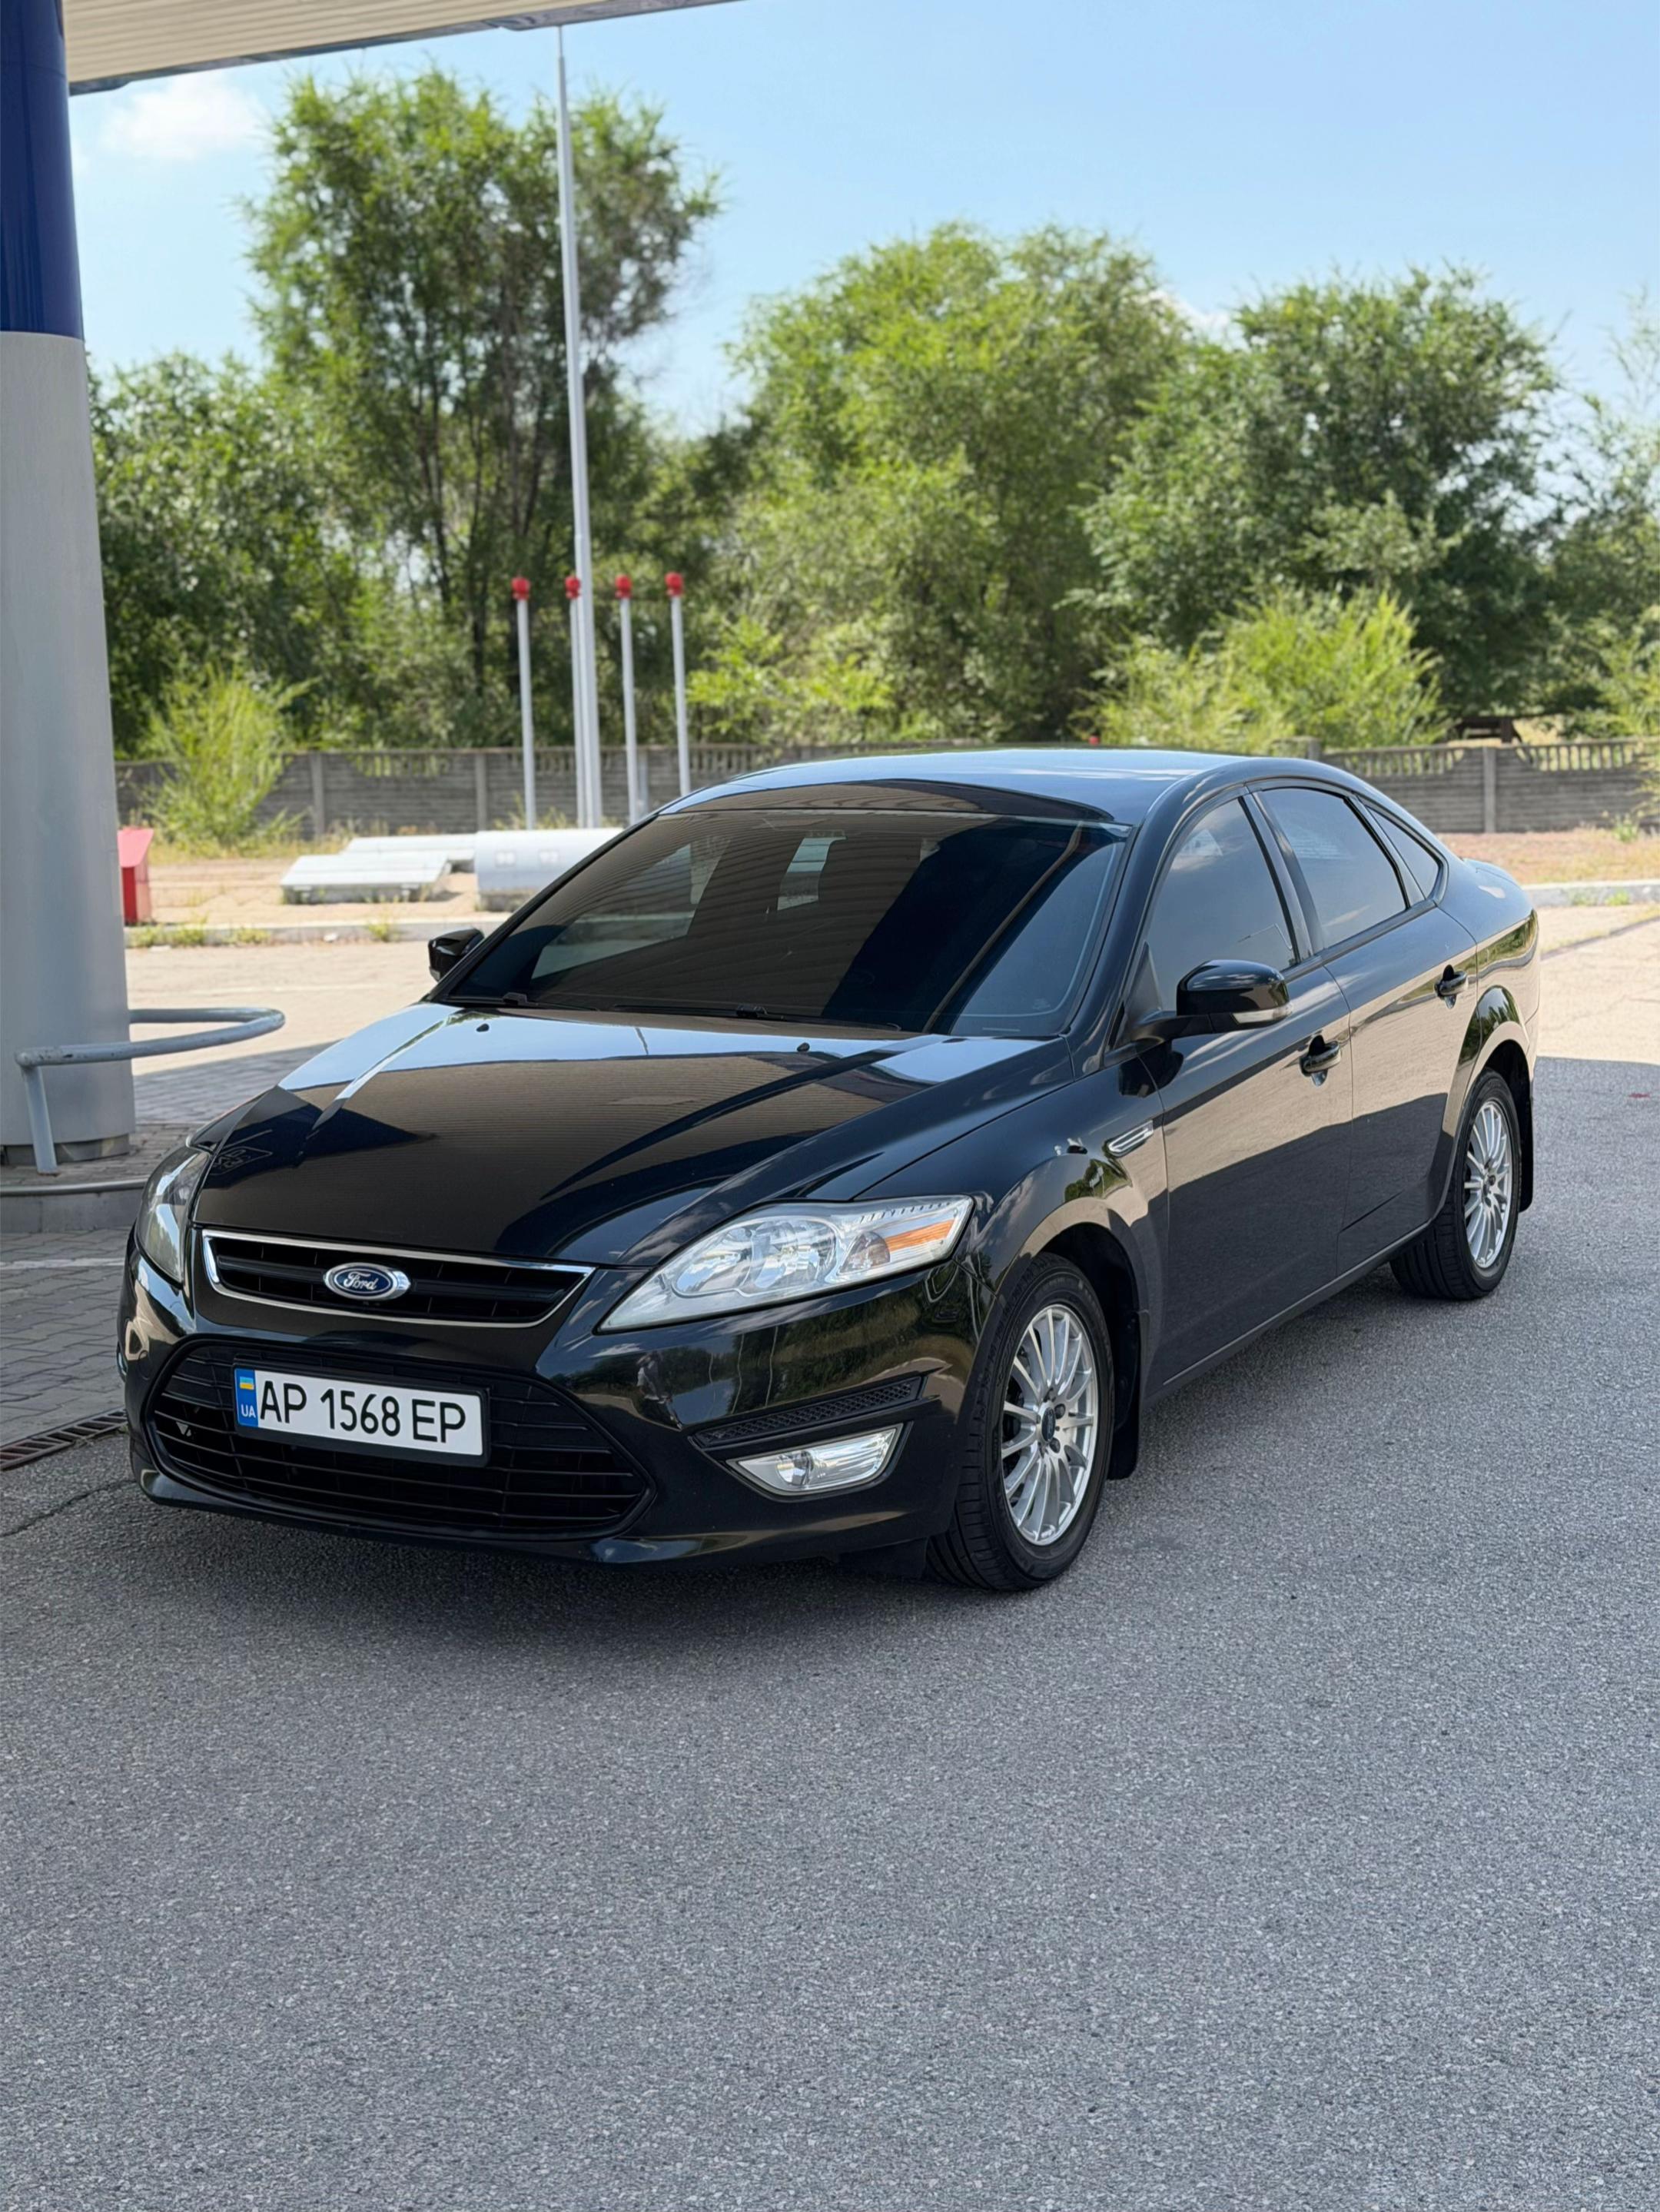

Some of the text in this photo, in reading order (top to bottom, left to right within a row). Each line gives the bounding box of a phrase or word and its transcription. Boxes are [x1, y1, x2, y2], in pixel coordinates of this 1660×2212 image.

[343, 1271, 379, 1290] Ford
[241, 1403, 257, 1419] UA
[260, 1380, 466, 1443] AP 1568 EP
